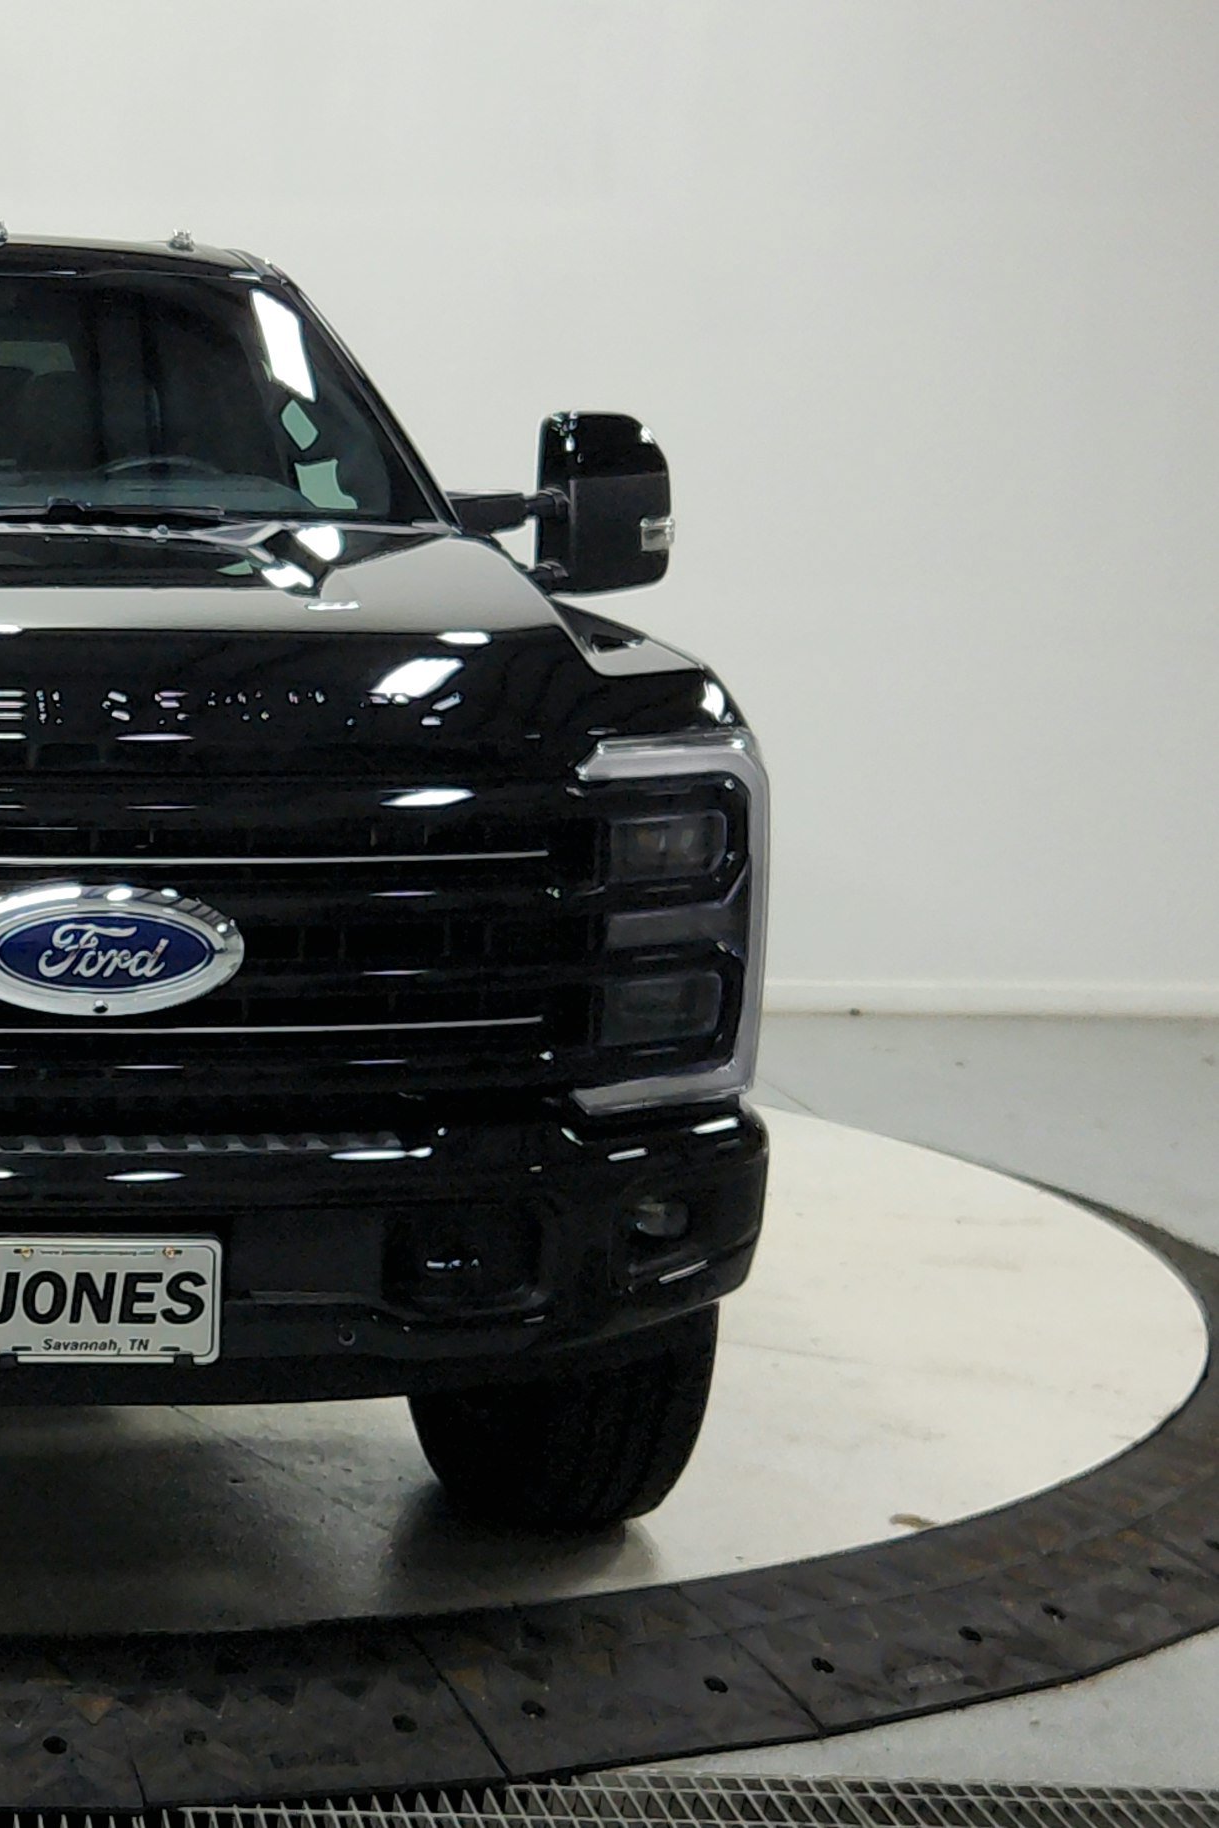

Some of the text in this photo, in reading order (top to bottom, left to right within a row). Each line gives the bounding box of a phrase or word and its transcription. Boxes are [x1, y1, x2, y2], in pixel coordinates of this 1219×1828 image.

[38, 923, 170, 978] Ford
[42, 1338, 150, 1355] Savannah, TN
